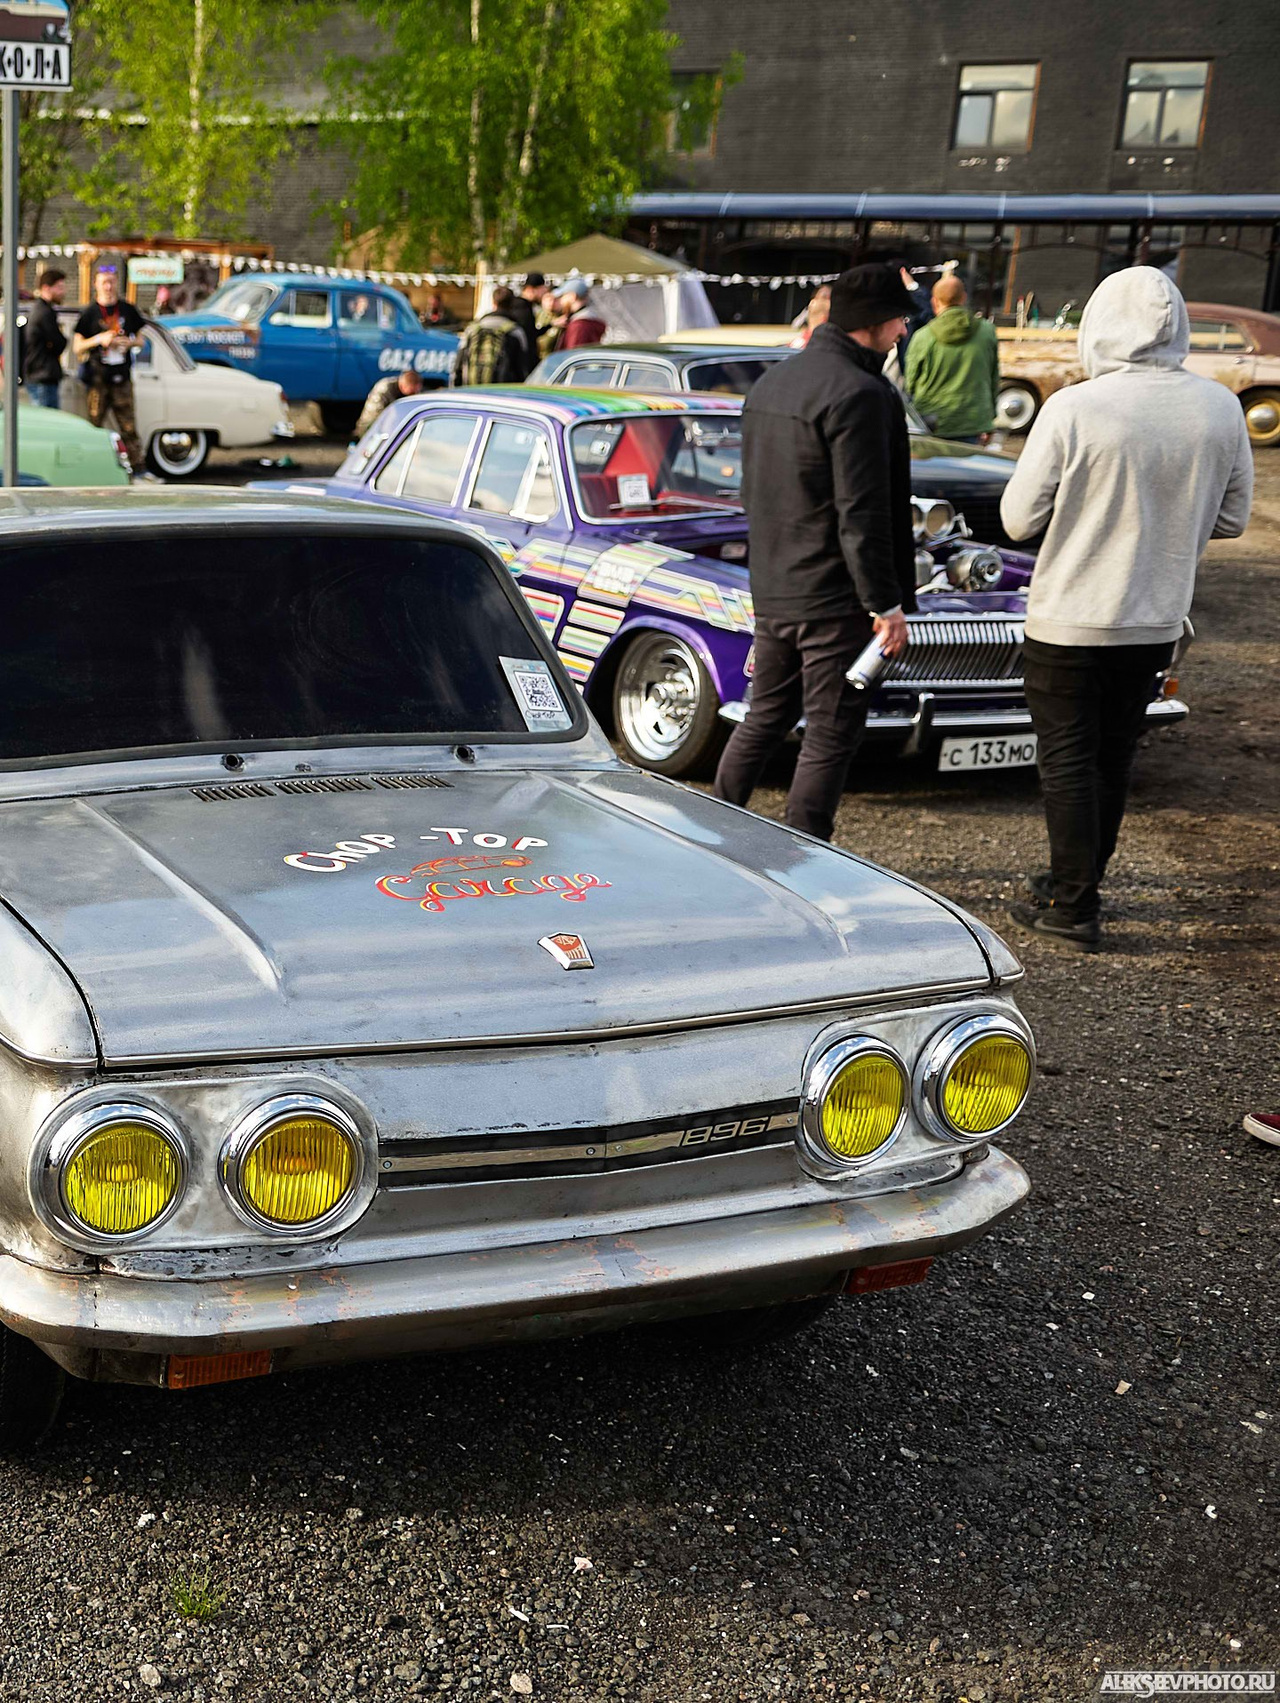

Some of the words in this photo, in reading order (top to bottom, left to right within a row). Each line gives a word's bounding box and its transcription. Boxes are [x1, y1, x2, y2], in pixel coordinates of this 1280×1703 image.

[206, 330, 245, 344] ROCKET
[378, 347, 414, 371] GAZ
[374, 872, 612, 912] Garage
[681, 1116, 769, 1146] 896
